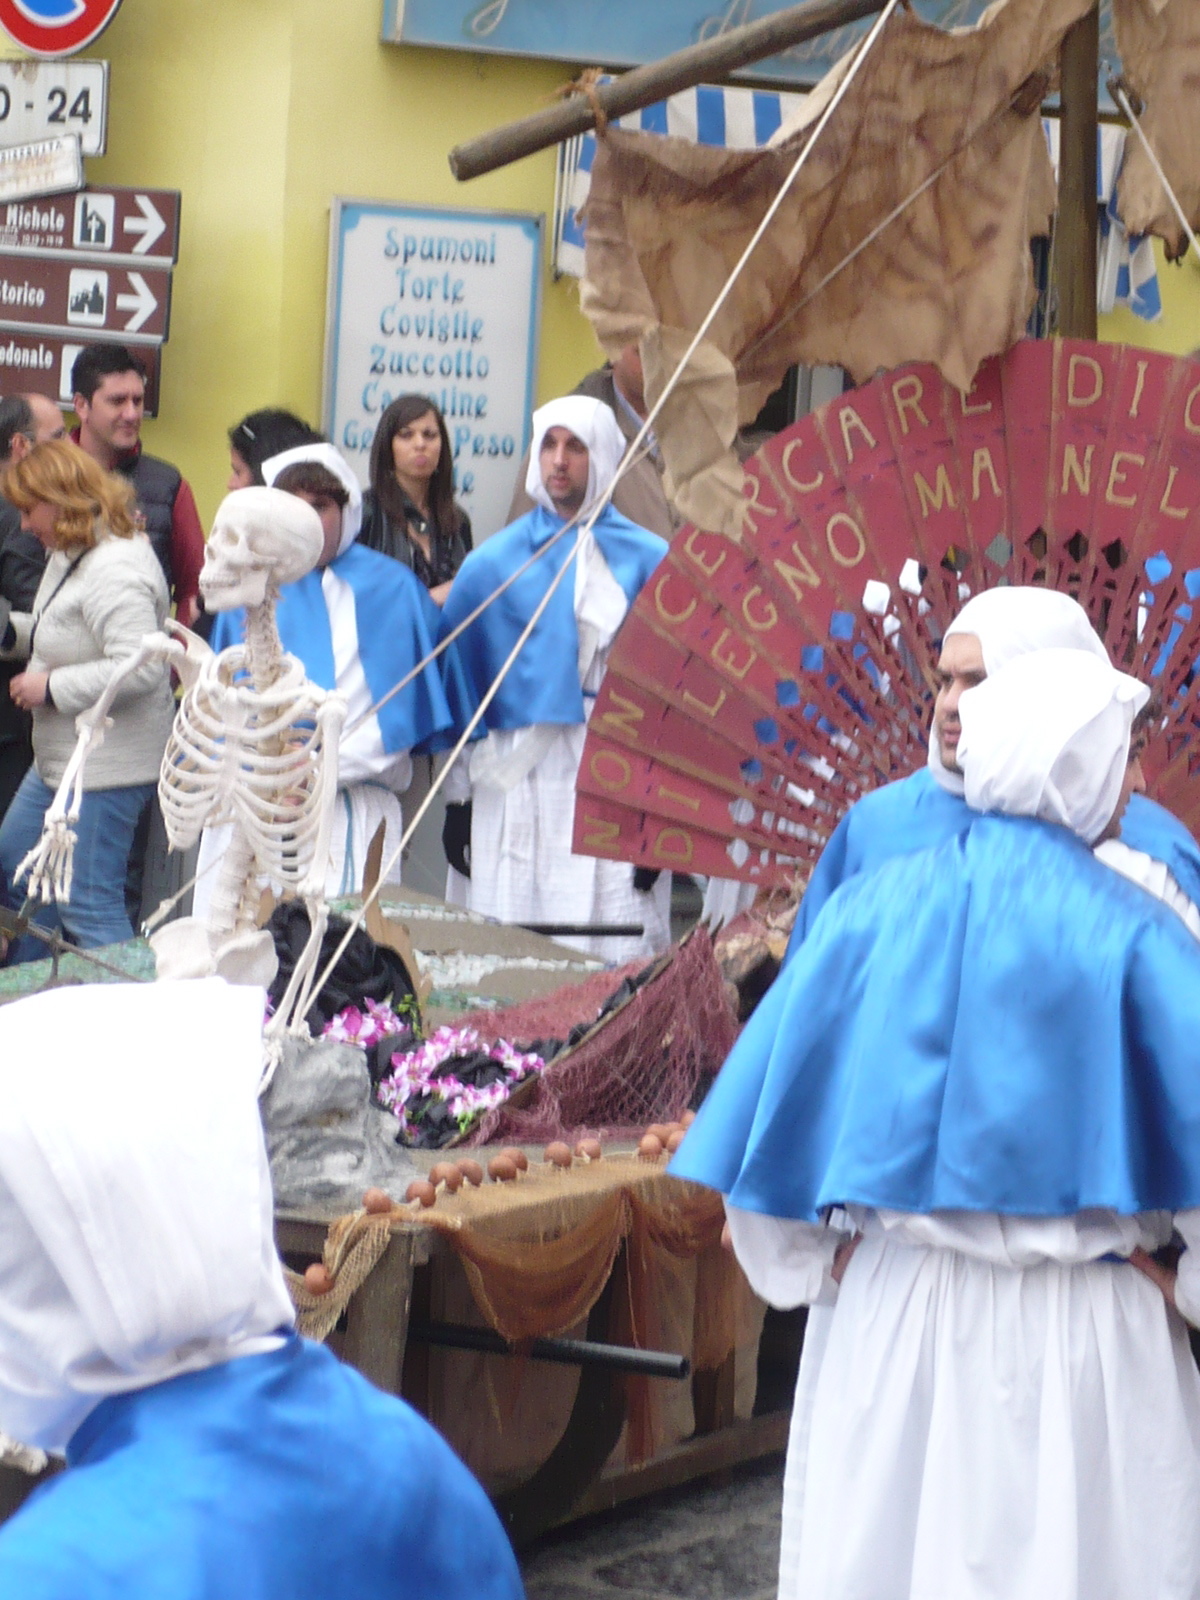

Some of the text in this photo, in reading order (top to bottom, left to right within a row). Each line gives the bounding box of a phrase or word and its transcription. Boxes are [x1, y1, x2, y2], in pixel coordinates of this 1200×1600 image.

[47, 86, 92, 124] 24
[384, 227, 496, 265] Spumoni
[0, 280, 45, 307] torico
[396, 267, 464, 304] Torte
[379, 303, 484, 343] Coviglie
[370, 344, 489, 379] Zuccotto
[453, 424, 515, 459] Peso
[653, 443, 1190, 865] DI LEGNO MA NEL
[581, 689, 645, 854] NON
